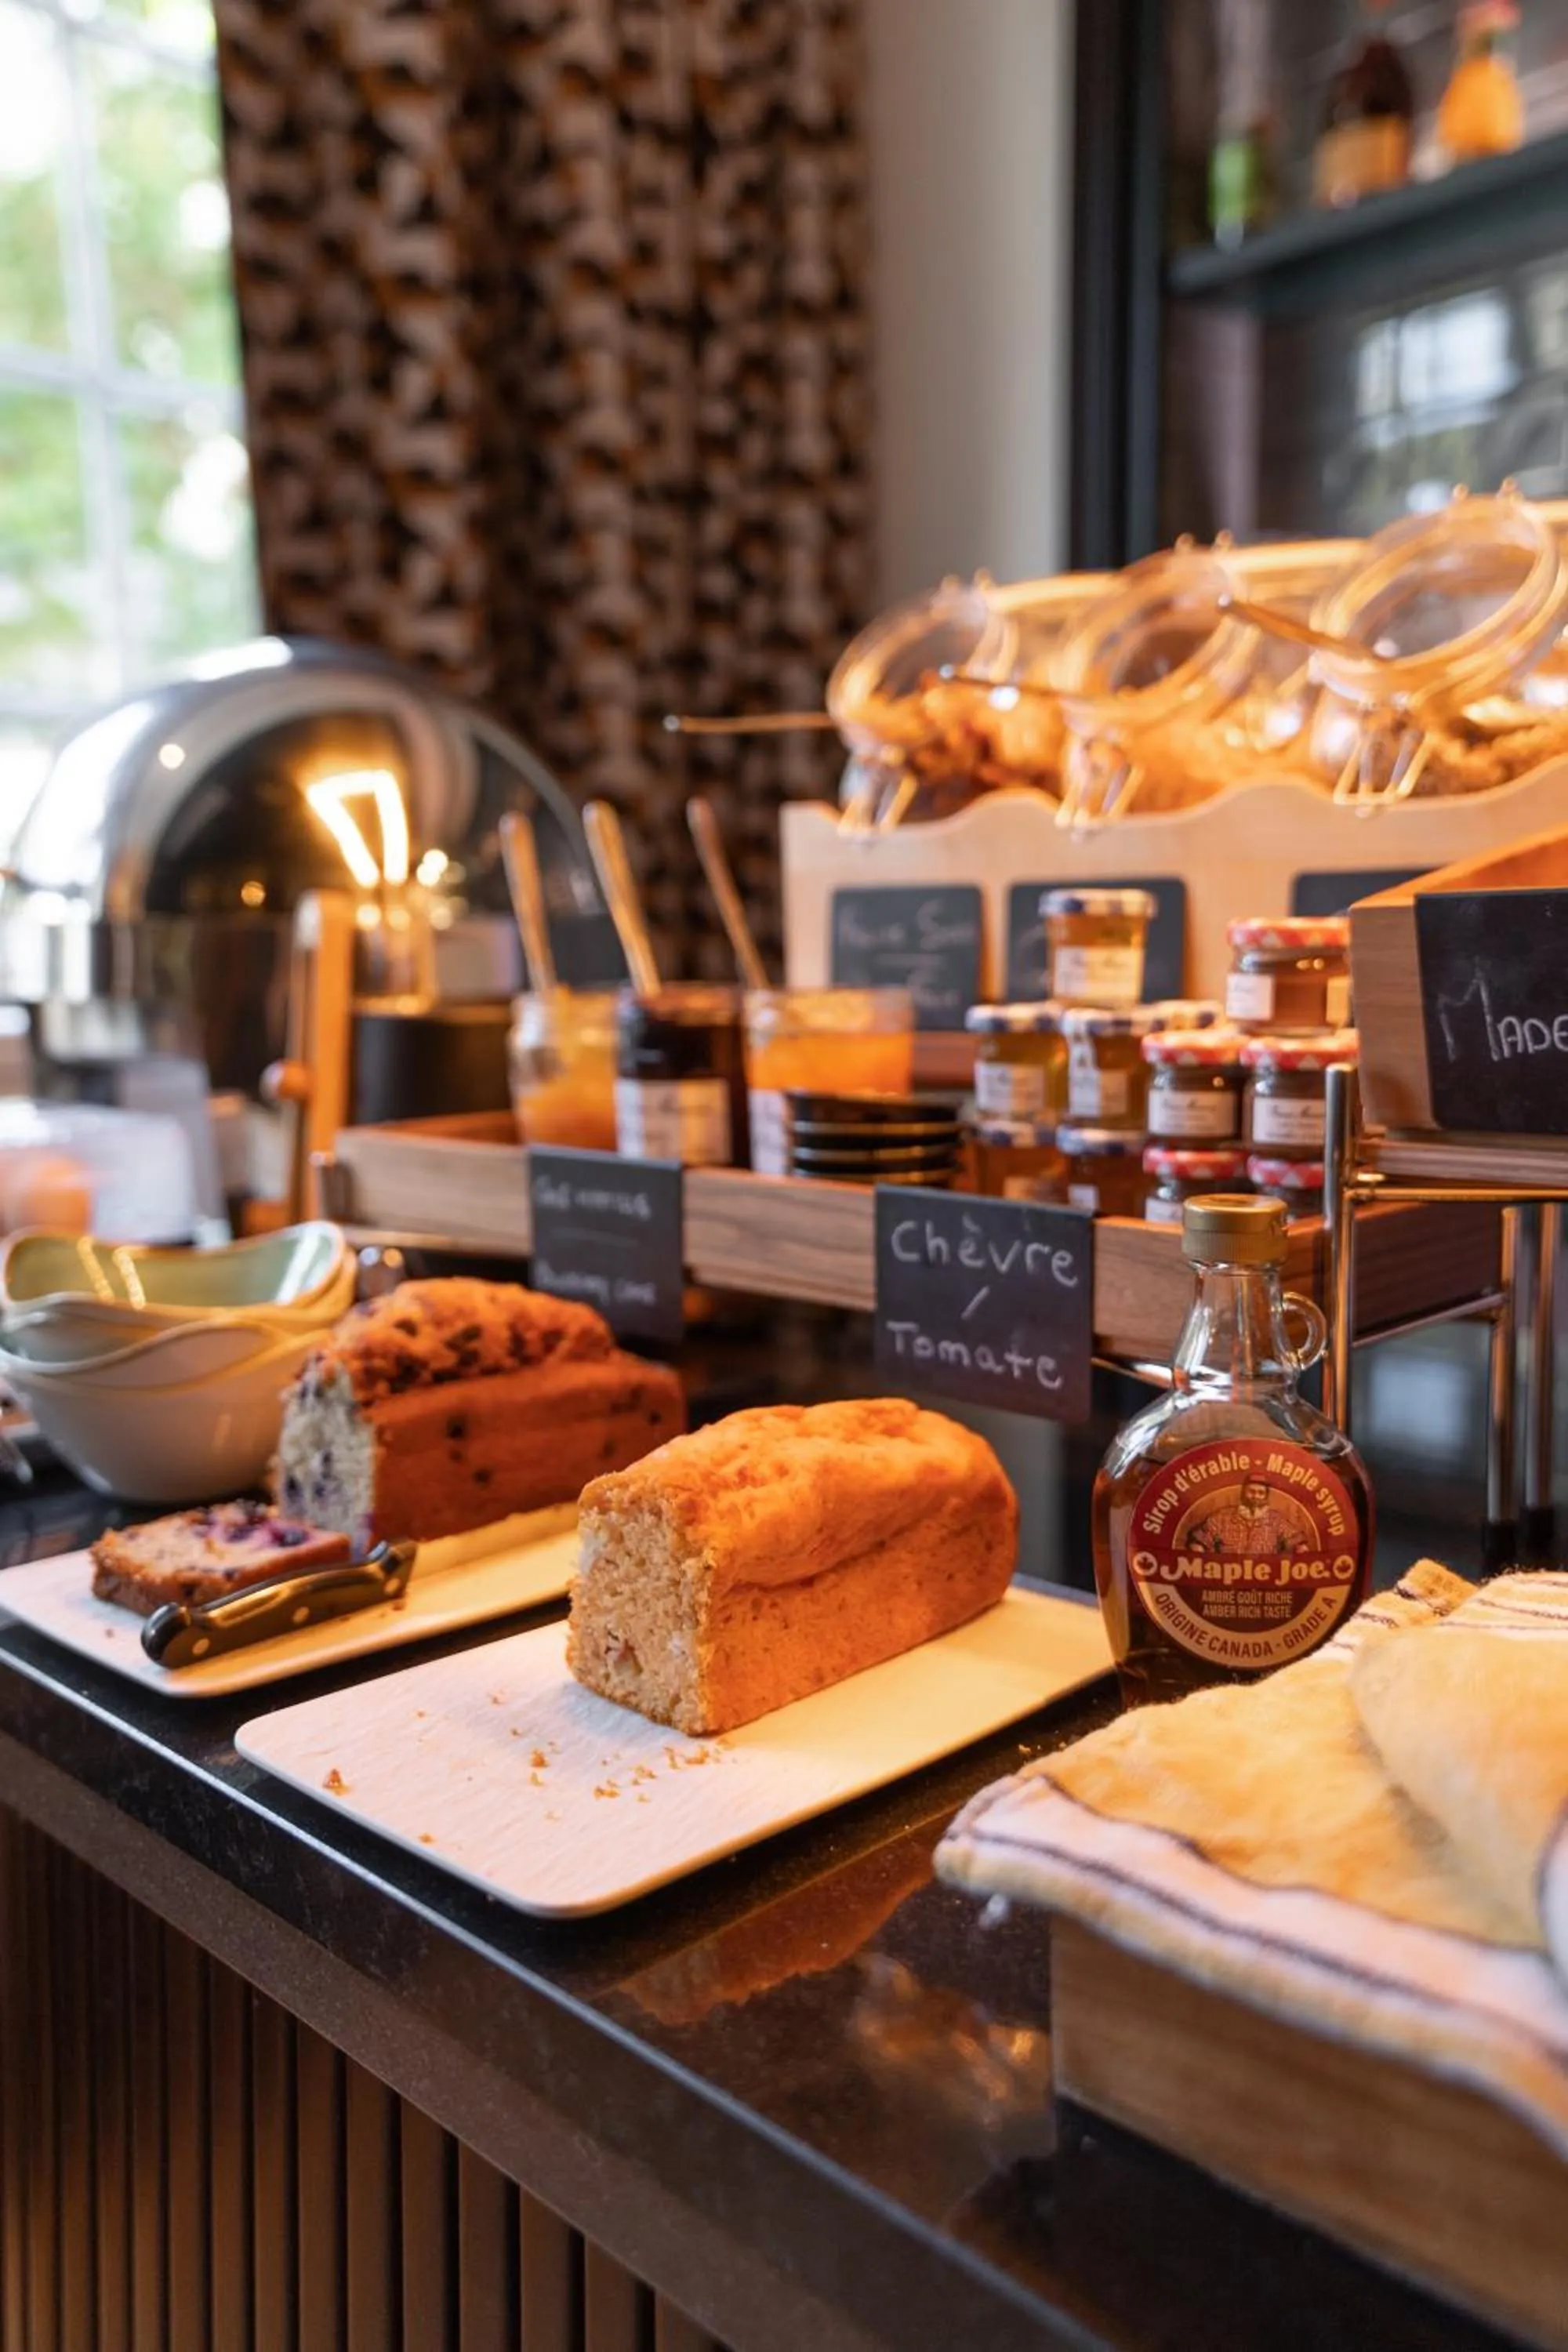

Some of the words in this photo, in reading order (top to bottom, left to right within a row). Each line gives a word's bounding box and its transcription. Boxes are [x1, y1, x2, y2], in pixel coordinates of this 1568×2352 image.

[891, 1213, 1078, 1287] Chèvre
[886, 1320, 1062, 1389] Tomate
[1143, 1488, 1179, 1534] Sirop
[1174, 1451, 1250, 1492] d'érable
[1266, 1454, 1317, 1490] Maple
[1315, 1488, 1345, 1537] syrup
[1160, 1556, 1272, 1585] Maple
[1156, 1592, 1208, 1646] ORIGINE
[1208, 1635, 1273, 1659] CANADA
[1283, 1607, 1327, 1649] GRADE
[1322, 1595, 1338, 1609] A
[1263, 1606, 1291, 1619] TASTE
